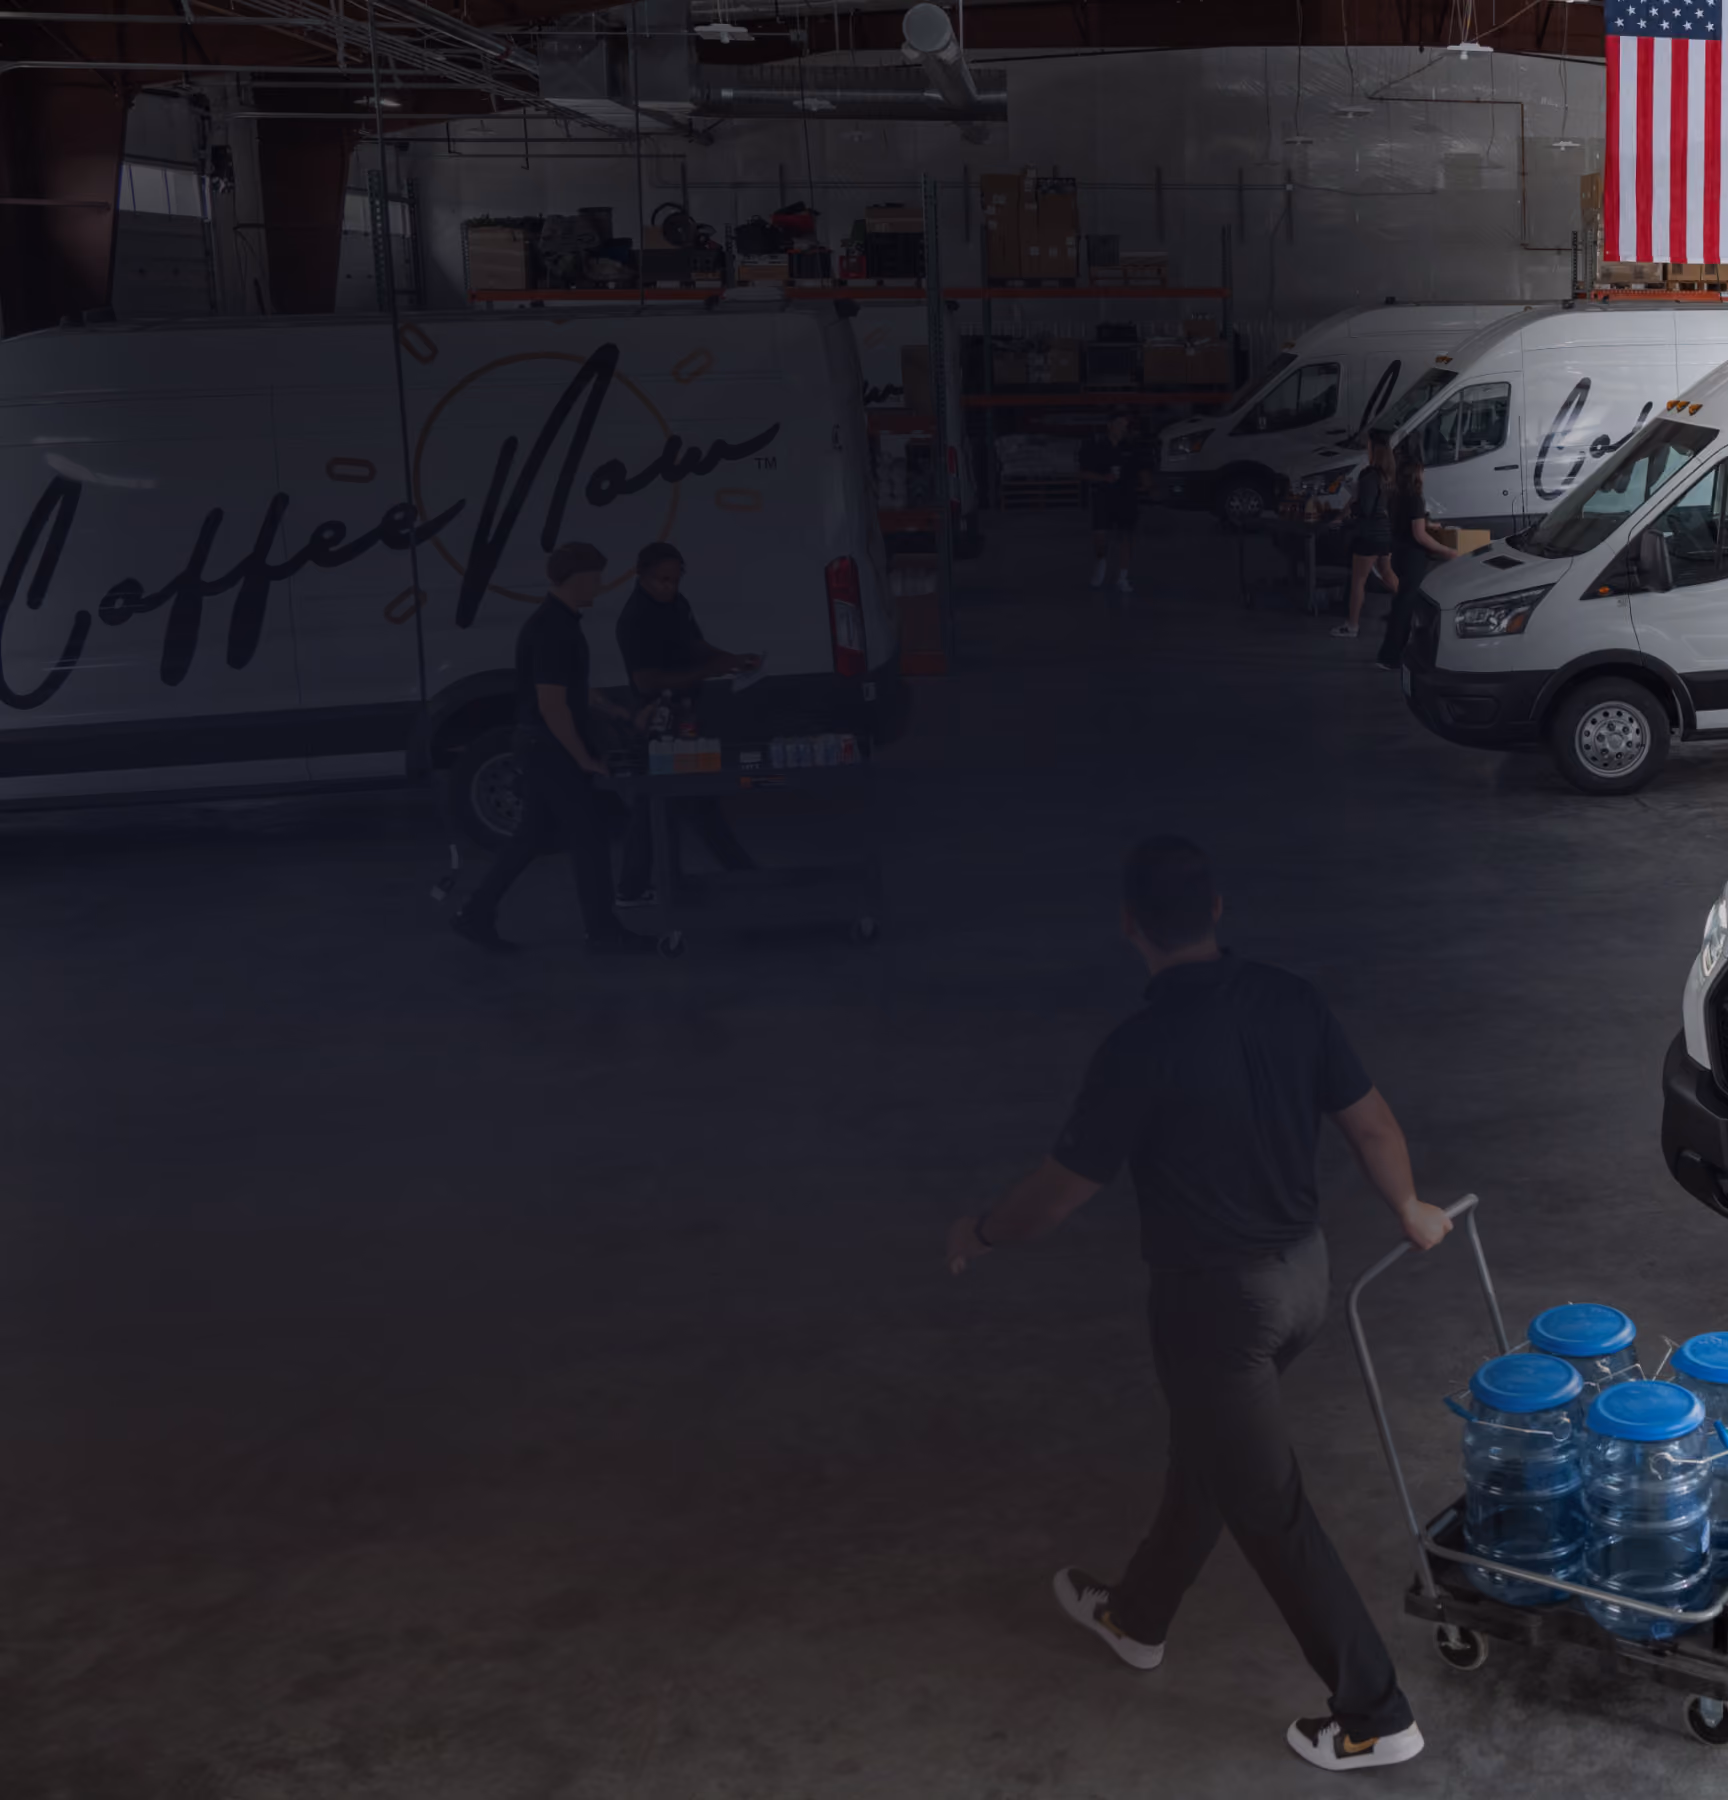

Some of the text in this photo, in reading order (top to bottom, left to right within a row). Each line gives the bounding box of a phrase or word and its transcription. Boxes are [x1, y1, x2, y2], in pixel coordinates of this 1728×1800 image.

[0, 342, 780, 710] Coffee Now TM
